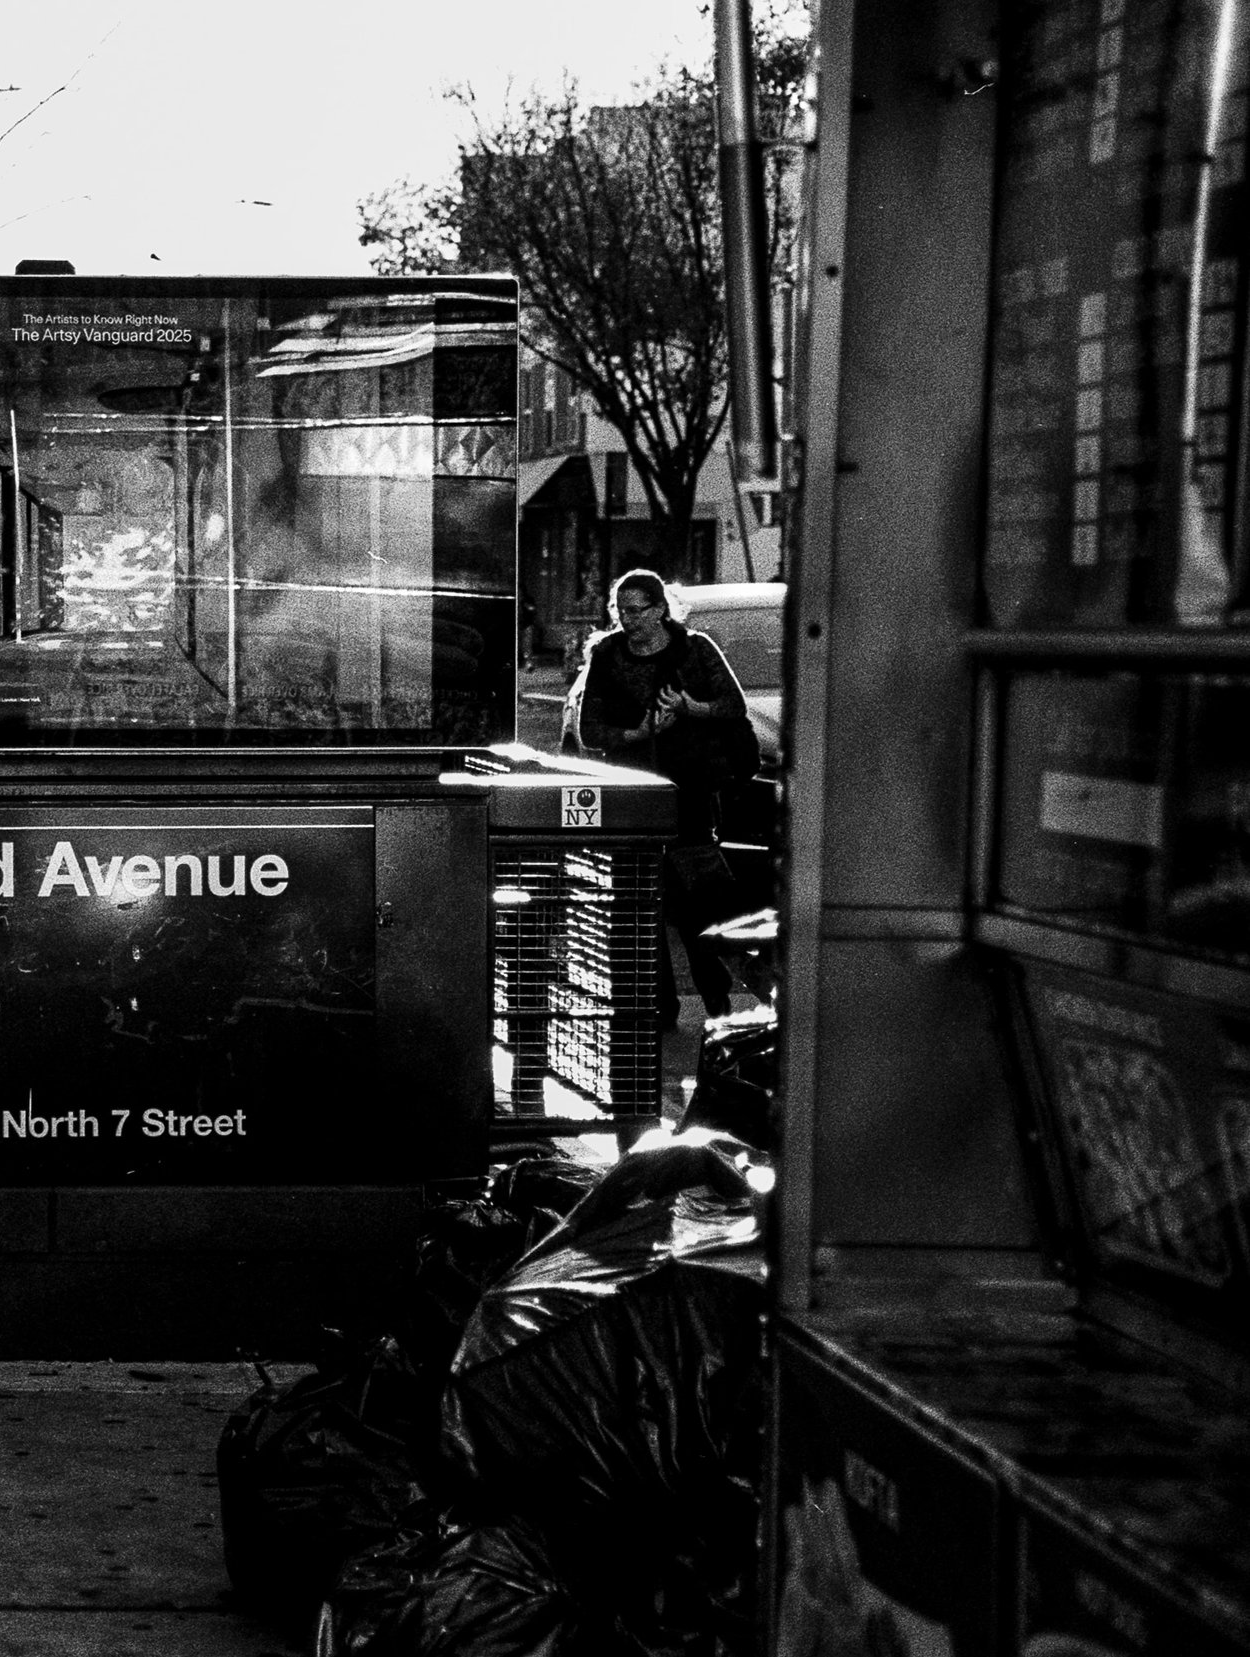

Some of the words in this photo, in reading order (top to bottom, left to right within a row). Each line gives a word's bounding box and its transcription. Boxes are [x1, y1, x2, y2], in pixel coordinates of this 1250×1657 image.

[23, 314, 43, 324] The
[45, 314, 79, 324] Artists
[81, 315, 92, 324] to
[93, 315, 123, 325] Know
[125, 315, 152, 327] Right
[154, 315, 178, 325] Now
[12, 328, 39, 341] The
[42, 328, 81, 345] Artsy
[83, 328, 153, 345] Vanguard
[156, 329, 192, 342] 2025
[567, 790, 576, 807] I
[565, 808, 599, 826] NY
[37, 841, 290, 897] Avenue
[1, 1109, 100, 1139] North
[110, 1110, 131, 1138] 7
[141, 1108, 247, 1137] Street
